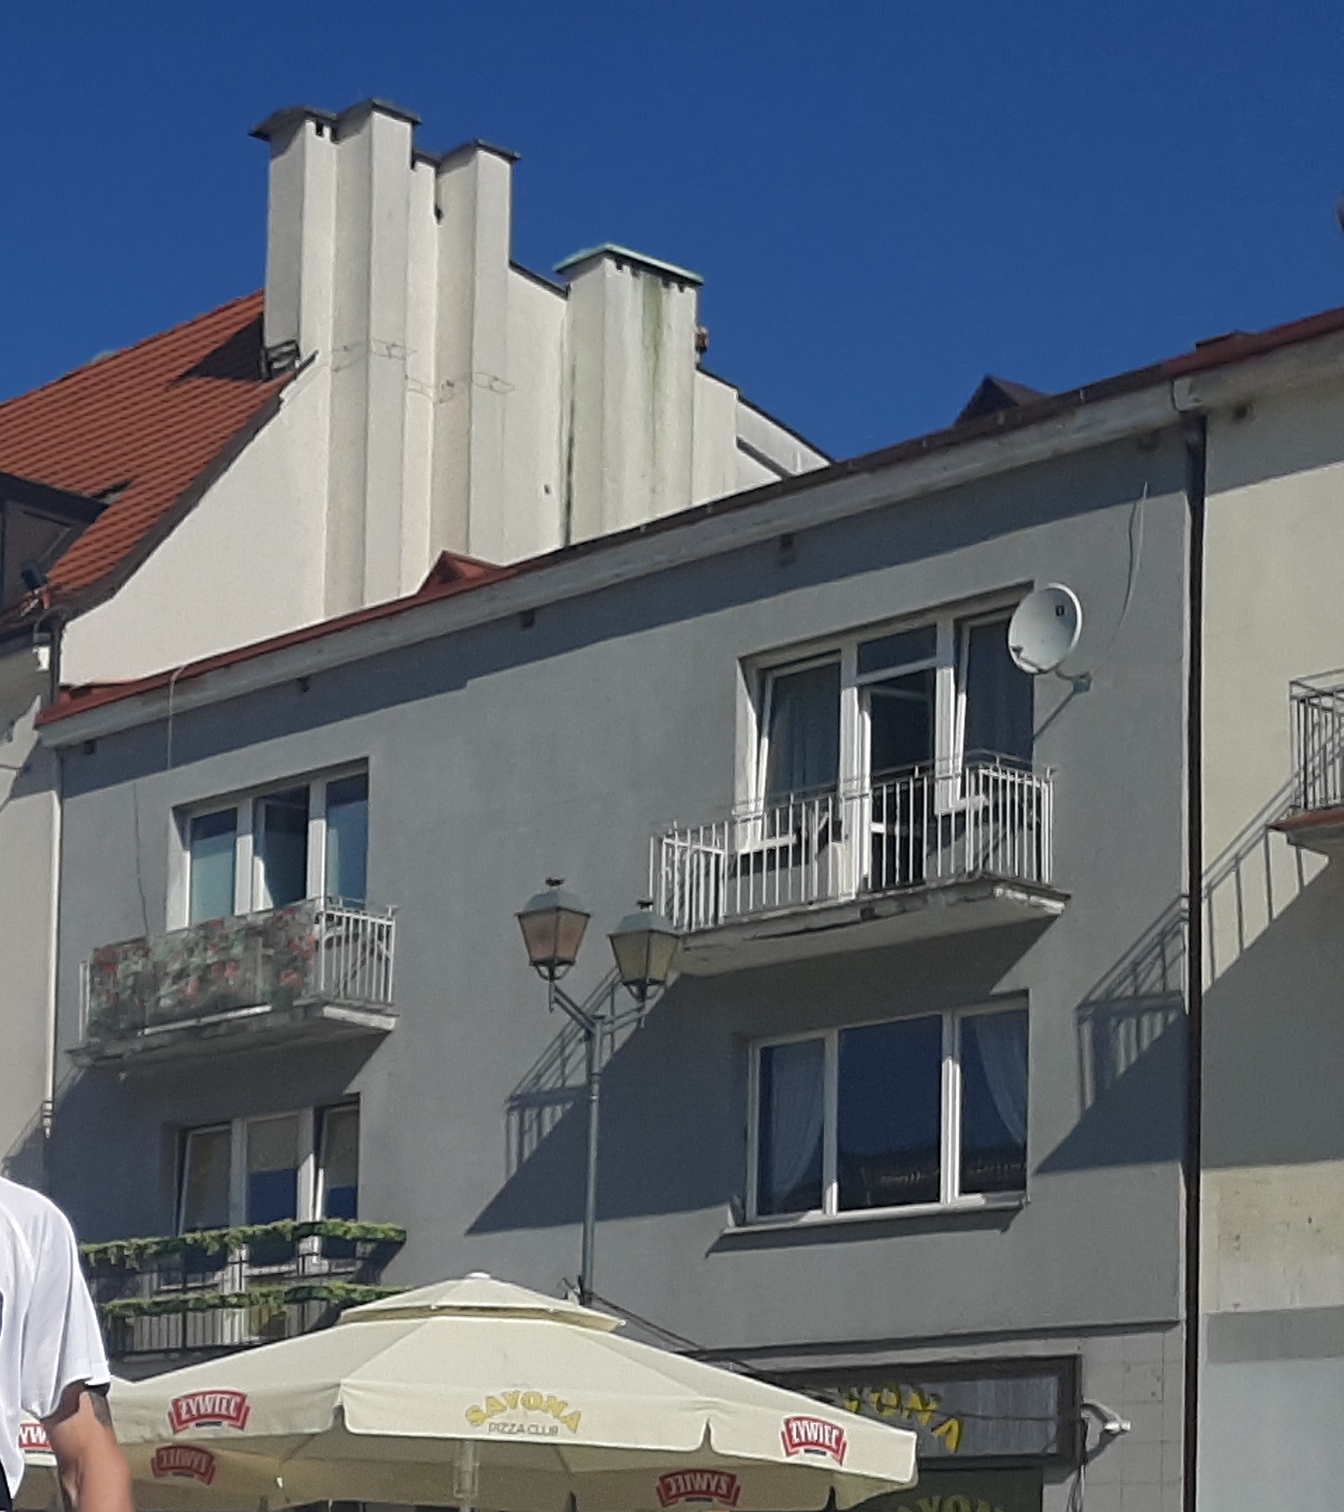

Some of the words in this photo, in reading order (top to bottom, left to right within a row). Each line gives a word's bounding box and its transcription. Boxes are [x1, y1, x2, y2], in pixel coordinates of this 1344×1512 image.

[465, 1390, 582, 1434] SAVONA
[488, 1422, 525, 1435] PIZZA
[527, 1424, 559, 1437] CLUB
